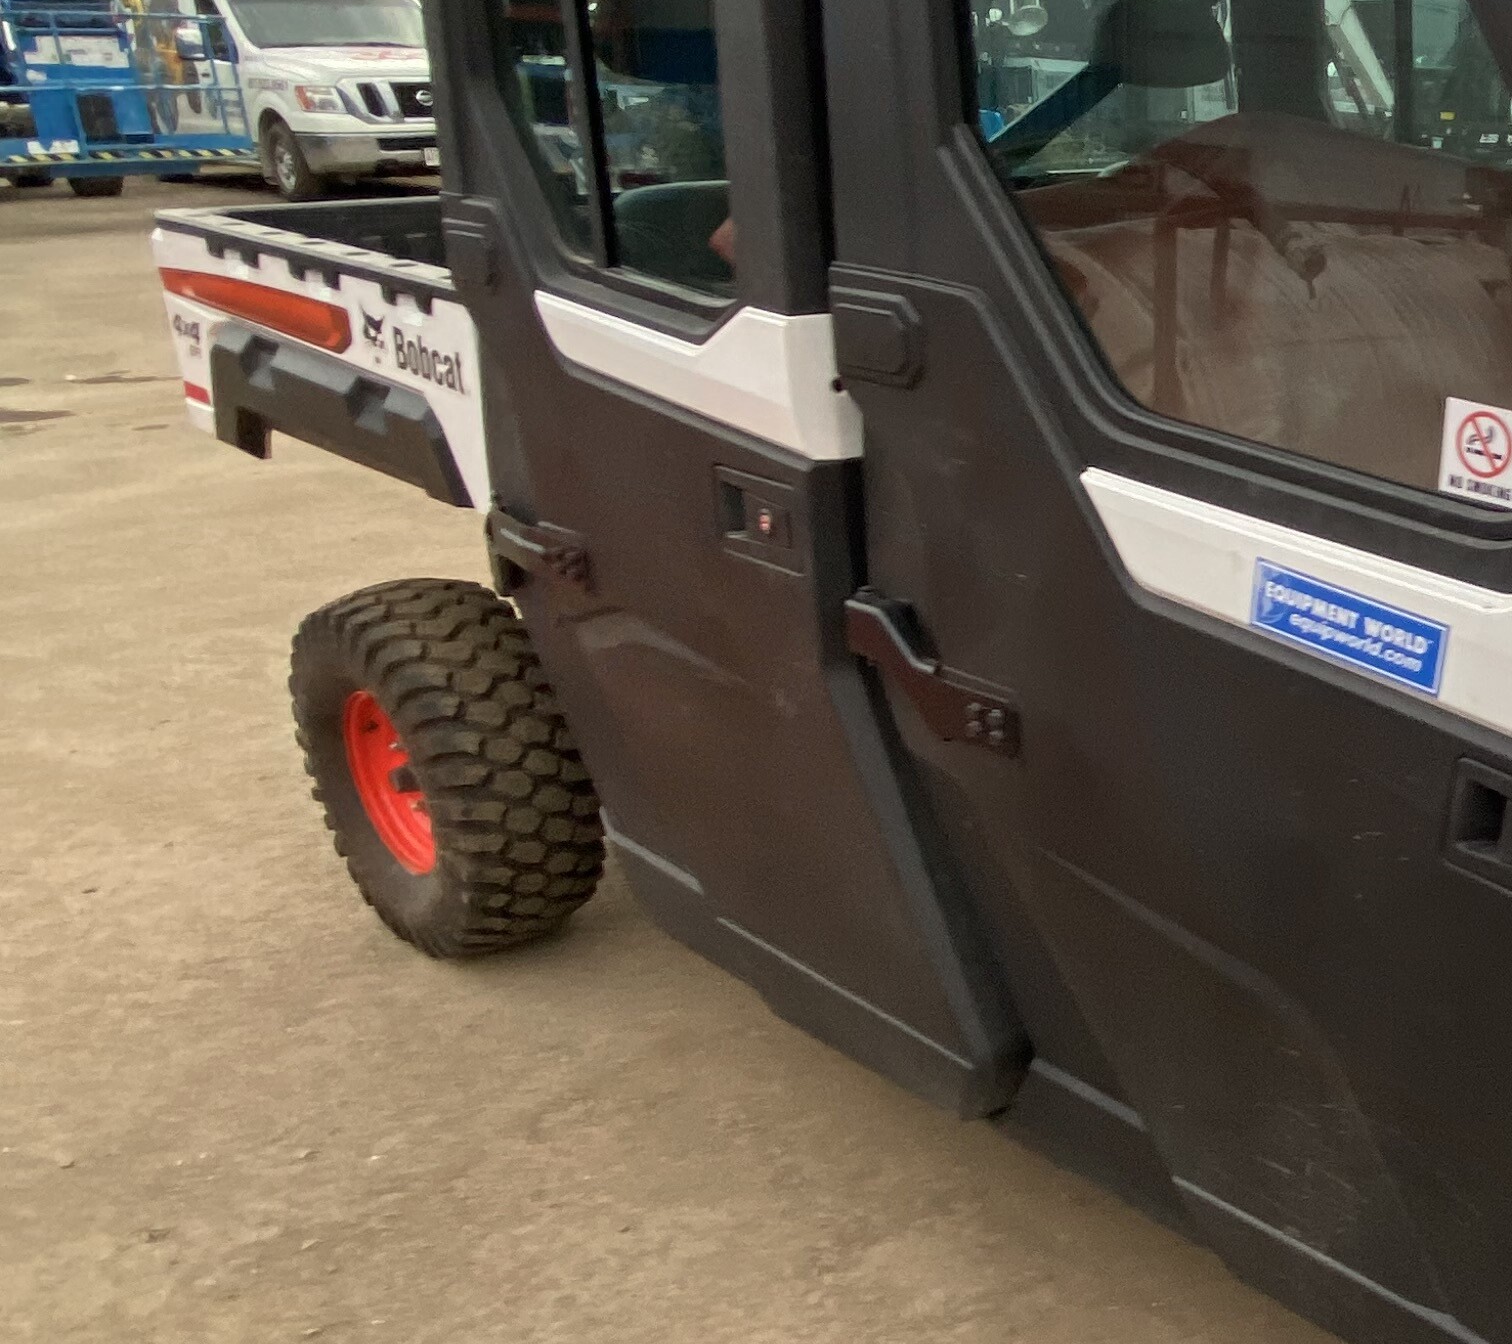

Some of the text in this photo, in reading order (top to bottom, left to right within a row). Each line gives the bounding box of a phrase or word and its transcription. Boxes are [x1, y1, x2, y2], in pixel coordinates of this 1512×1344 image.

[393, 326, 467, 396] Bobcat
[1265, 580, 1428, 655] EQUIPMENT WORLD
[1288, 612, 1423, 673] equipworld.com
